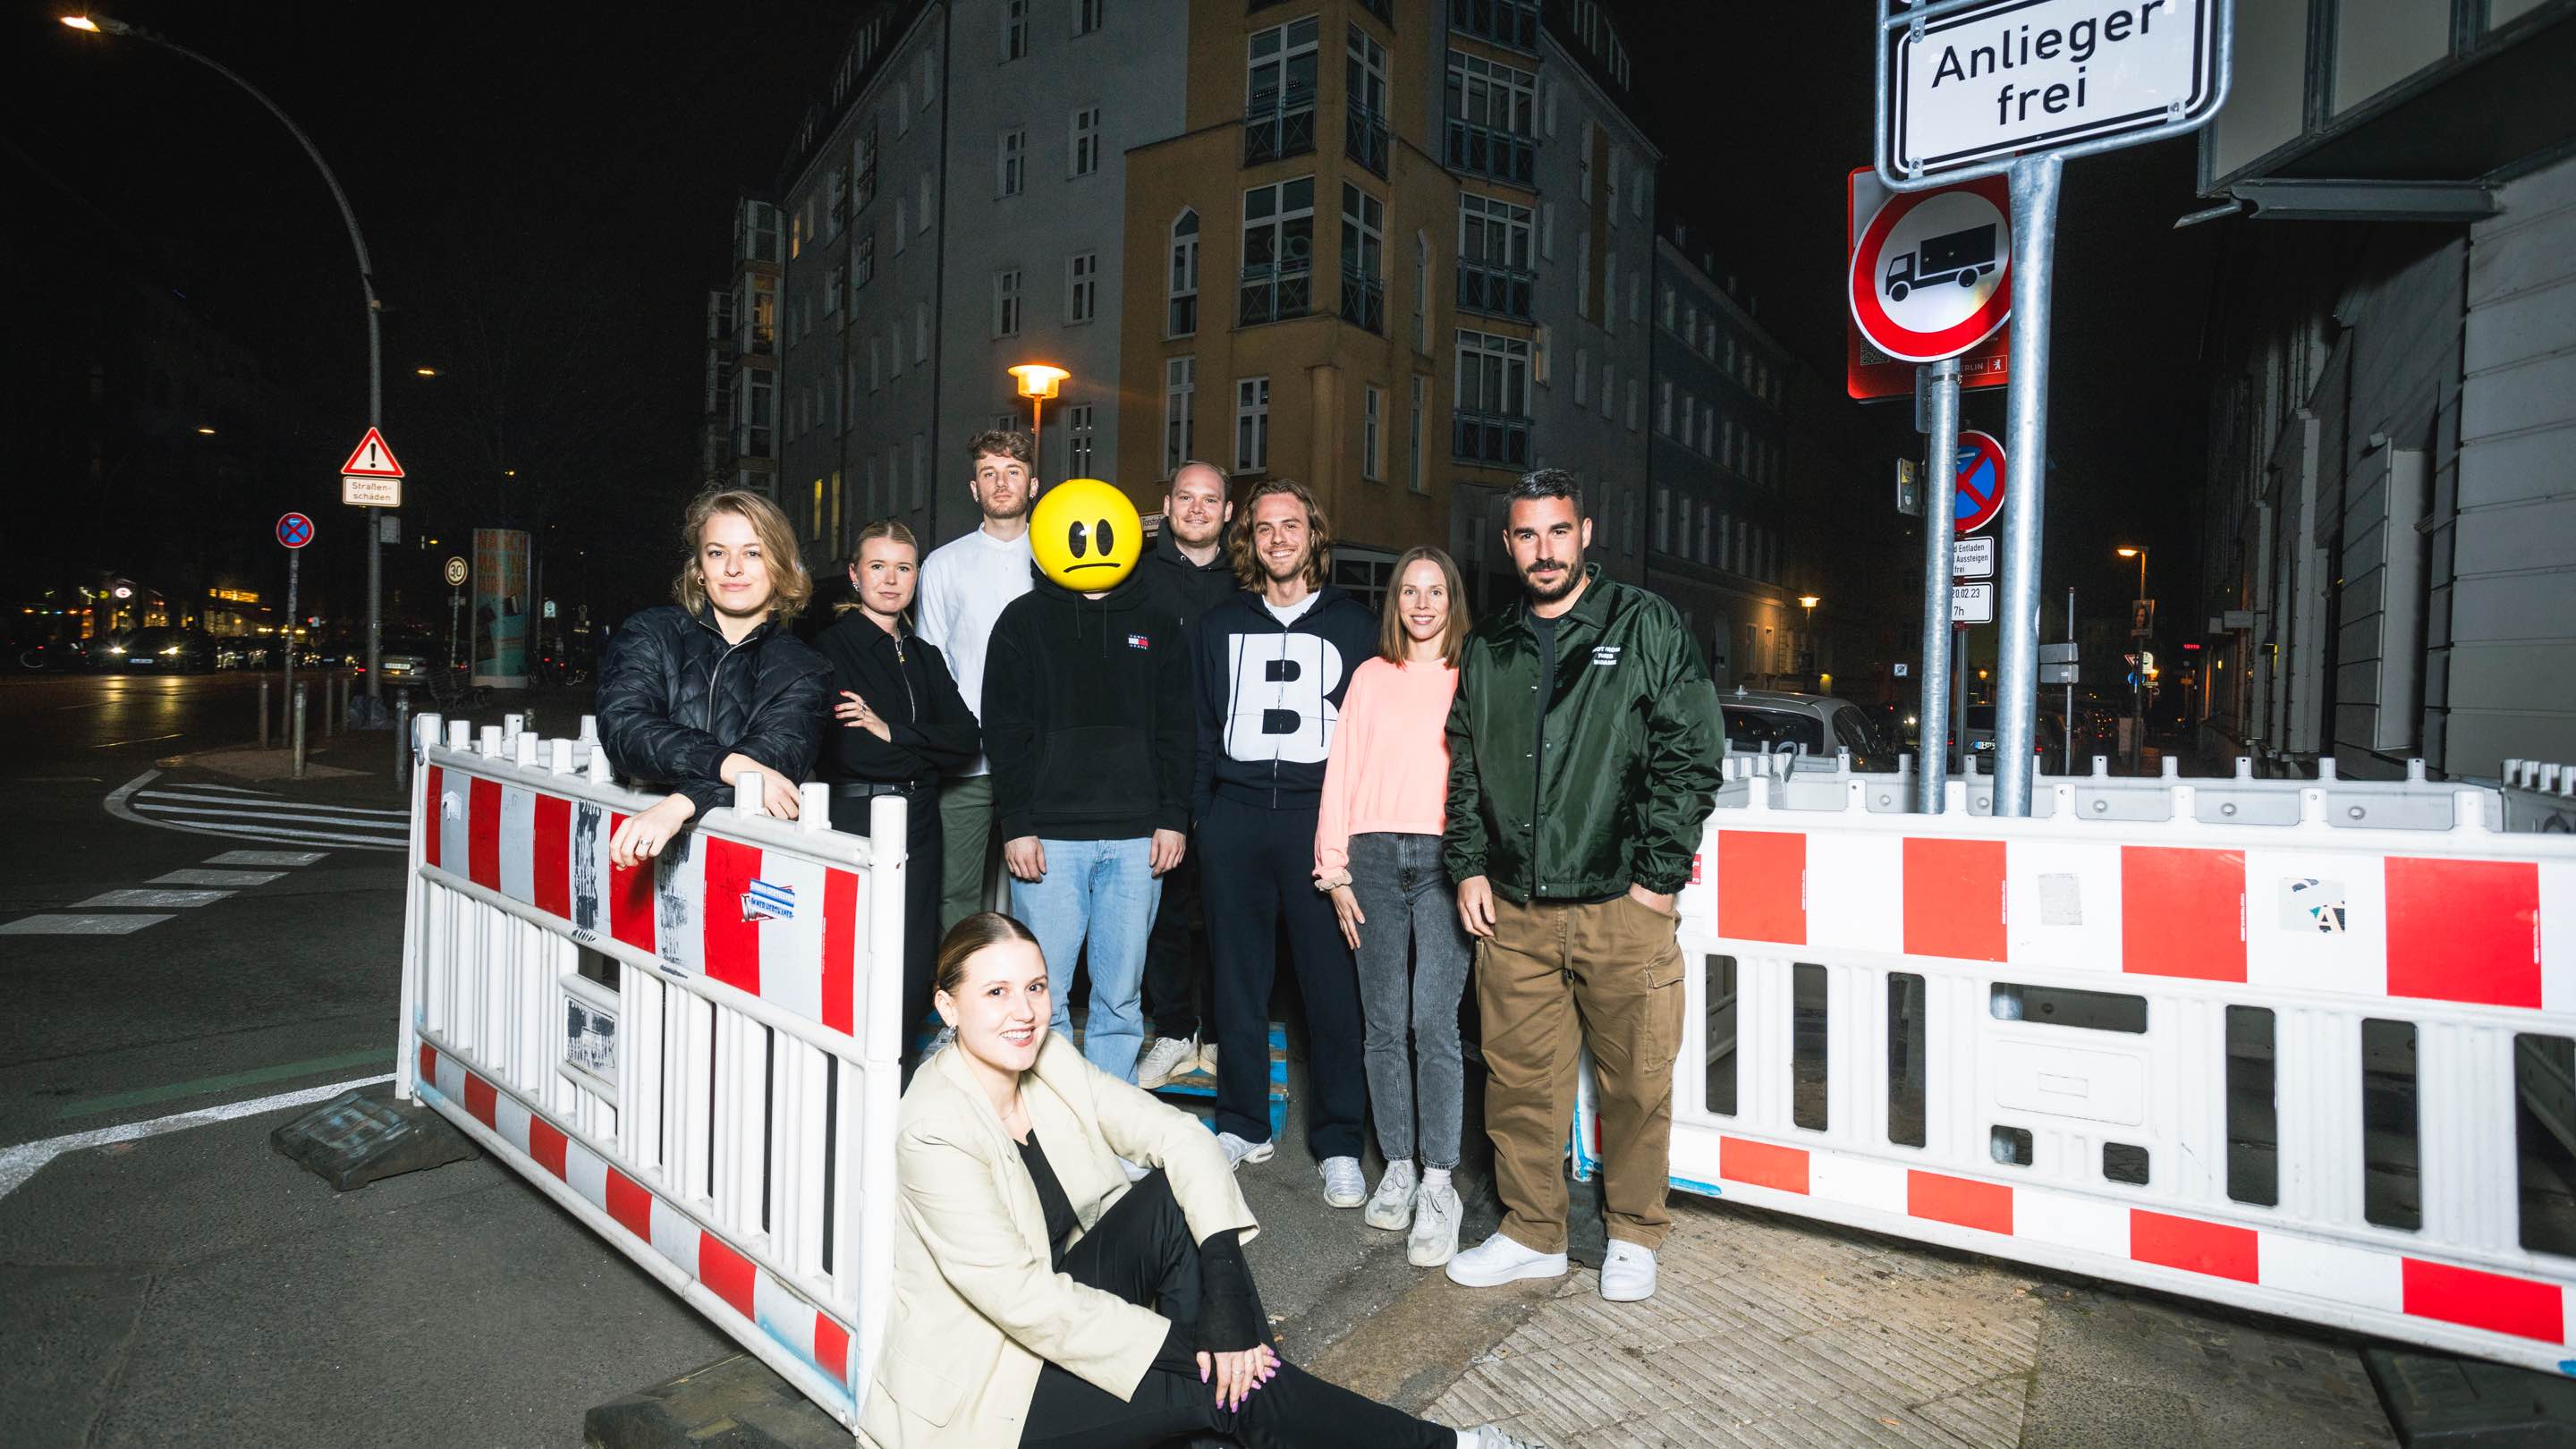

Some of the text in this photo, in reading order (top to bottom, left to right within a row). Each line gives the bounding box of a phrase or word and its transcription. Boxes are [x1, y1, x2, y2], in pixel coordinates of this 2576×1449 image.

[1931, 0, 2165, 88] Anlieger
[1996, 66, 2087, 125] frei
[1961, 362, 1983, 372] ERLIN
[1959, 544, 1985, 553] Entladen
[1956, 555, 1988, 564] Aussteigen
[450, 564, 462, 578] 30
[1954, 565, 1965, 573] frei
[1224, 632, 1343, 764] B
